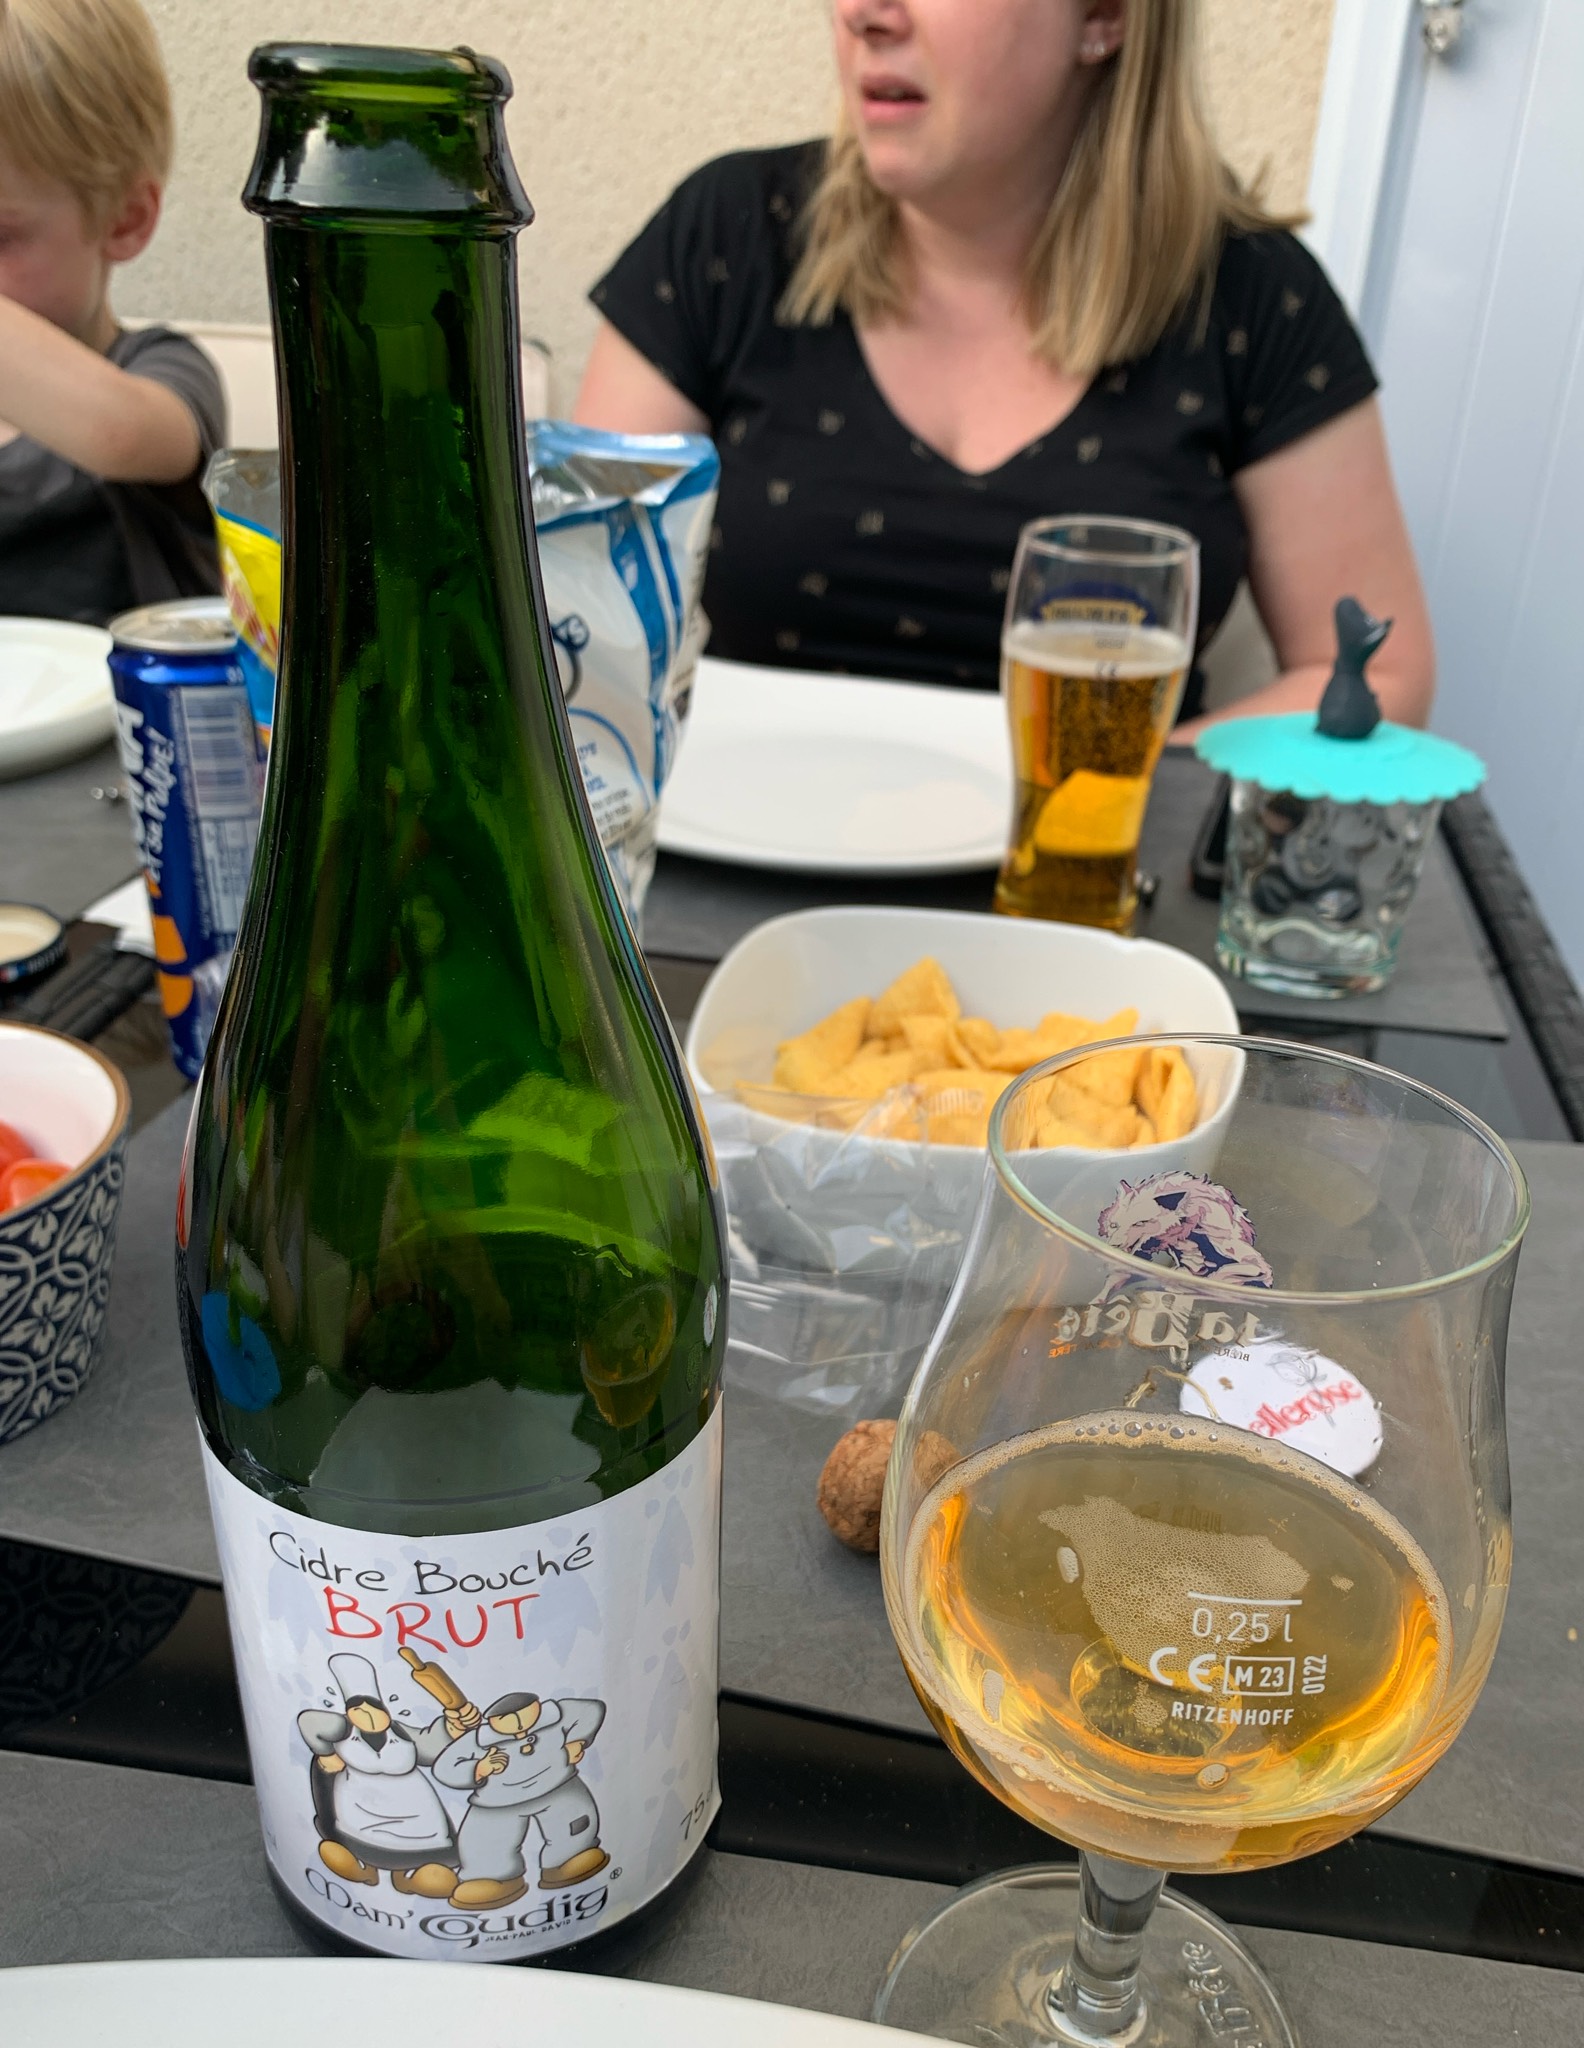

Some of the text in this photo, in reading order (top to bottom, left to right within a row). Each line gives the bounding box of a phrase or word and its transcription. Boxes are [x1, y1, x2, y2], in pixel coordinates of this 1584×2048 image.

[268, 1530, 596, 1596] Cidre Bouché
[323, 1585, 541, 1653] BRUT
[1191, 1607, 1271, 1644] 0,25
[1234, 1665, 1254, 1687] M
[1258, 1665, 1285, 1688] 23
[1301, 1653, 1328, 1695] 0122
[1171, 1701, 1295, 1726] RITZENHOFF
